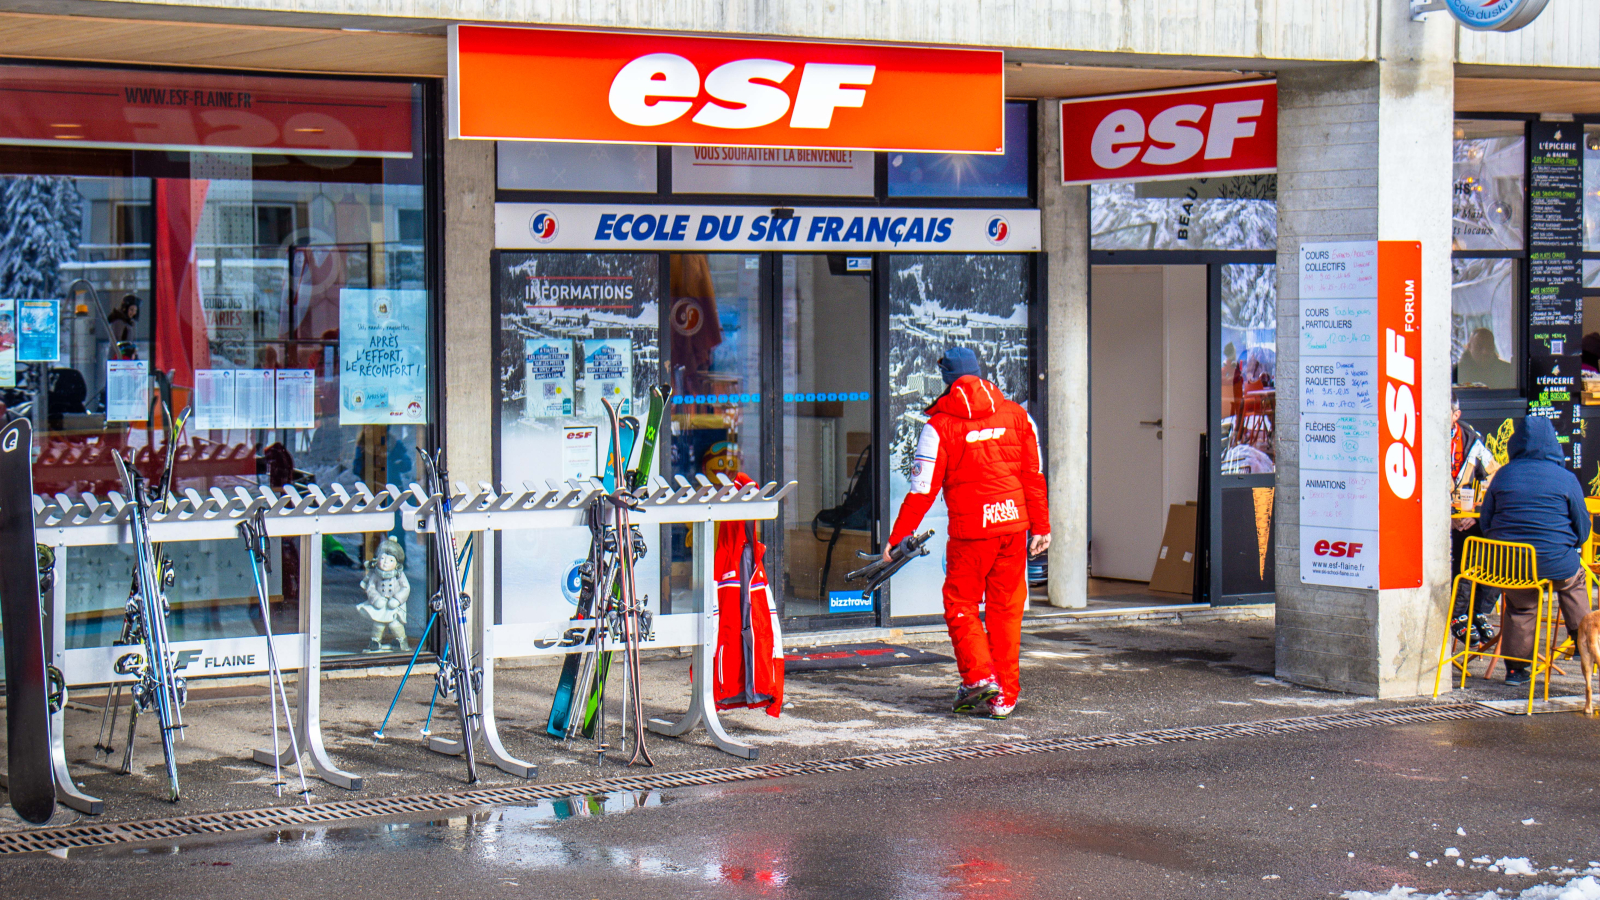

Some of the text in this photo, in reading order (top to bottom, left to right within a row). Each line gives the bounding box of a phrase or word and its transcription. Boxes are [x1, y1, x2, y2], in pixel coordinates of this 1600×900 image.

[124, 86, 252, 108] WWW.ESF-FLAINE.FR
[1538, 141, 1577, 150] L'ÉPICERIE
[693, 146, 718, 162] VOUS
[721, 147, 781, 162] SOUHAITENT
[783, 148, 795, 162] LA
[1177, 186, 1199, 241] BEAU
[594, 213, 690, 242] ECOLE
[695, 214, 742, 242] DU
[748, 214, 800, 242] SKI
[806, 216, 955, 248] FRANÇAIS
[1464, 225, 1493, 235] locaux
[1305, 251, 1329, 260] COURS
[1305, 262, 1345, 271] COLLECTIFS
[525, 285, 634, 300] INFORMATIONS
[1404, 279, 1415, 333] FORUM
[204, 310, 242, 326] TARIFS
[1305, 308, 1329, 317] COURS
[1305, 320, 1352, 329] PARTICULIERS
[369, 333, 399, 348] APRÈS
[346, 360, 357, 371] LE
[359, 363, 414, 378] RÉCONFORT
[1305, 365, 1334, 374] SORTIES
[1305, 377, 1345, 386] RAQUETTES
[1536, 376, 1574, 385] L'ÉPICERIE
[1305, 420, 1336, 431] FLÈCHES
[1305, 434, 1336, 443] CHAMOIS
[1305, 479, 1346, 490] ANIMATIONS
[1312, 561, 1365, 571] www.esf-flaine.fr
[830, 595, 872, 608] bizztravel
[204, 654, 256, 669] FLAINE
